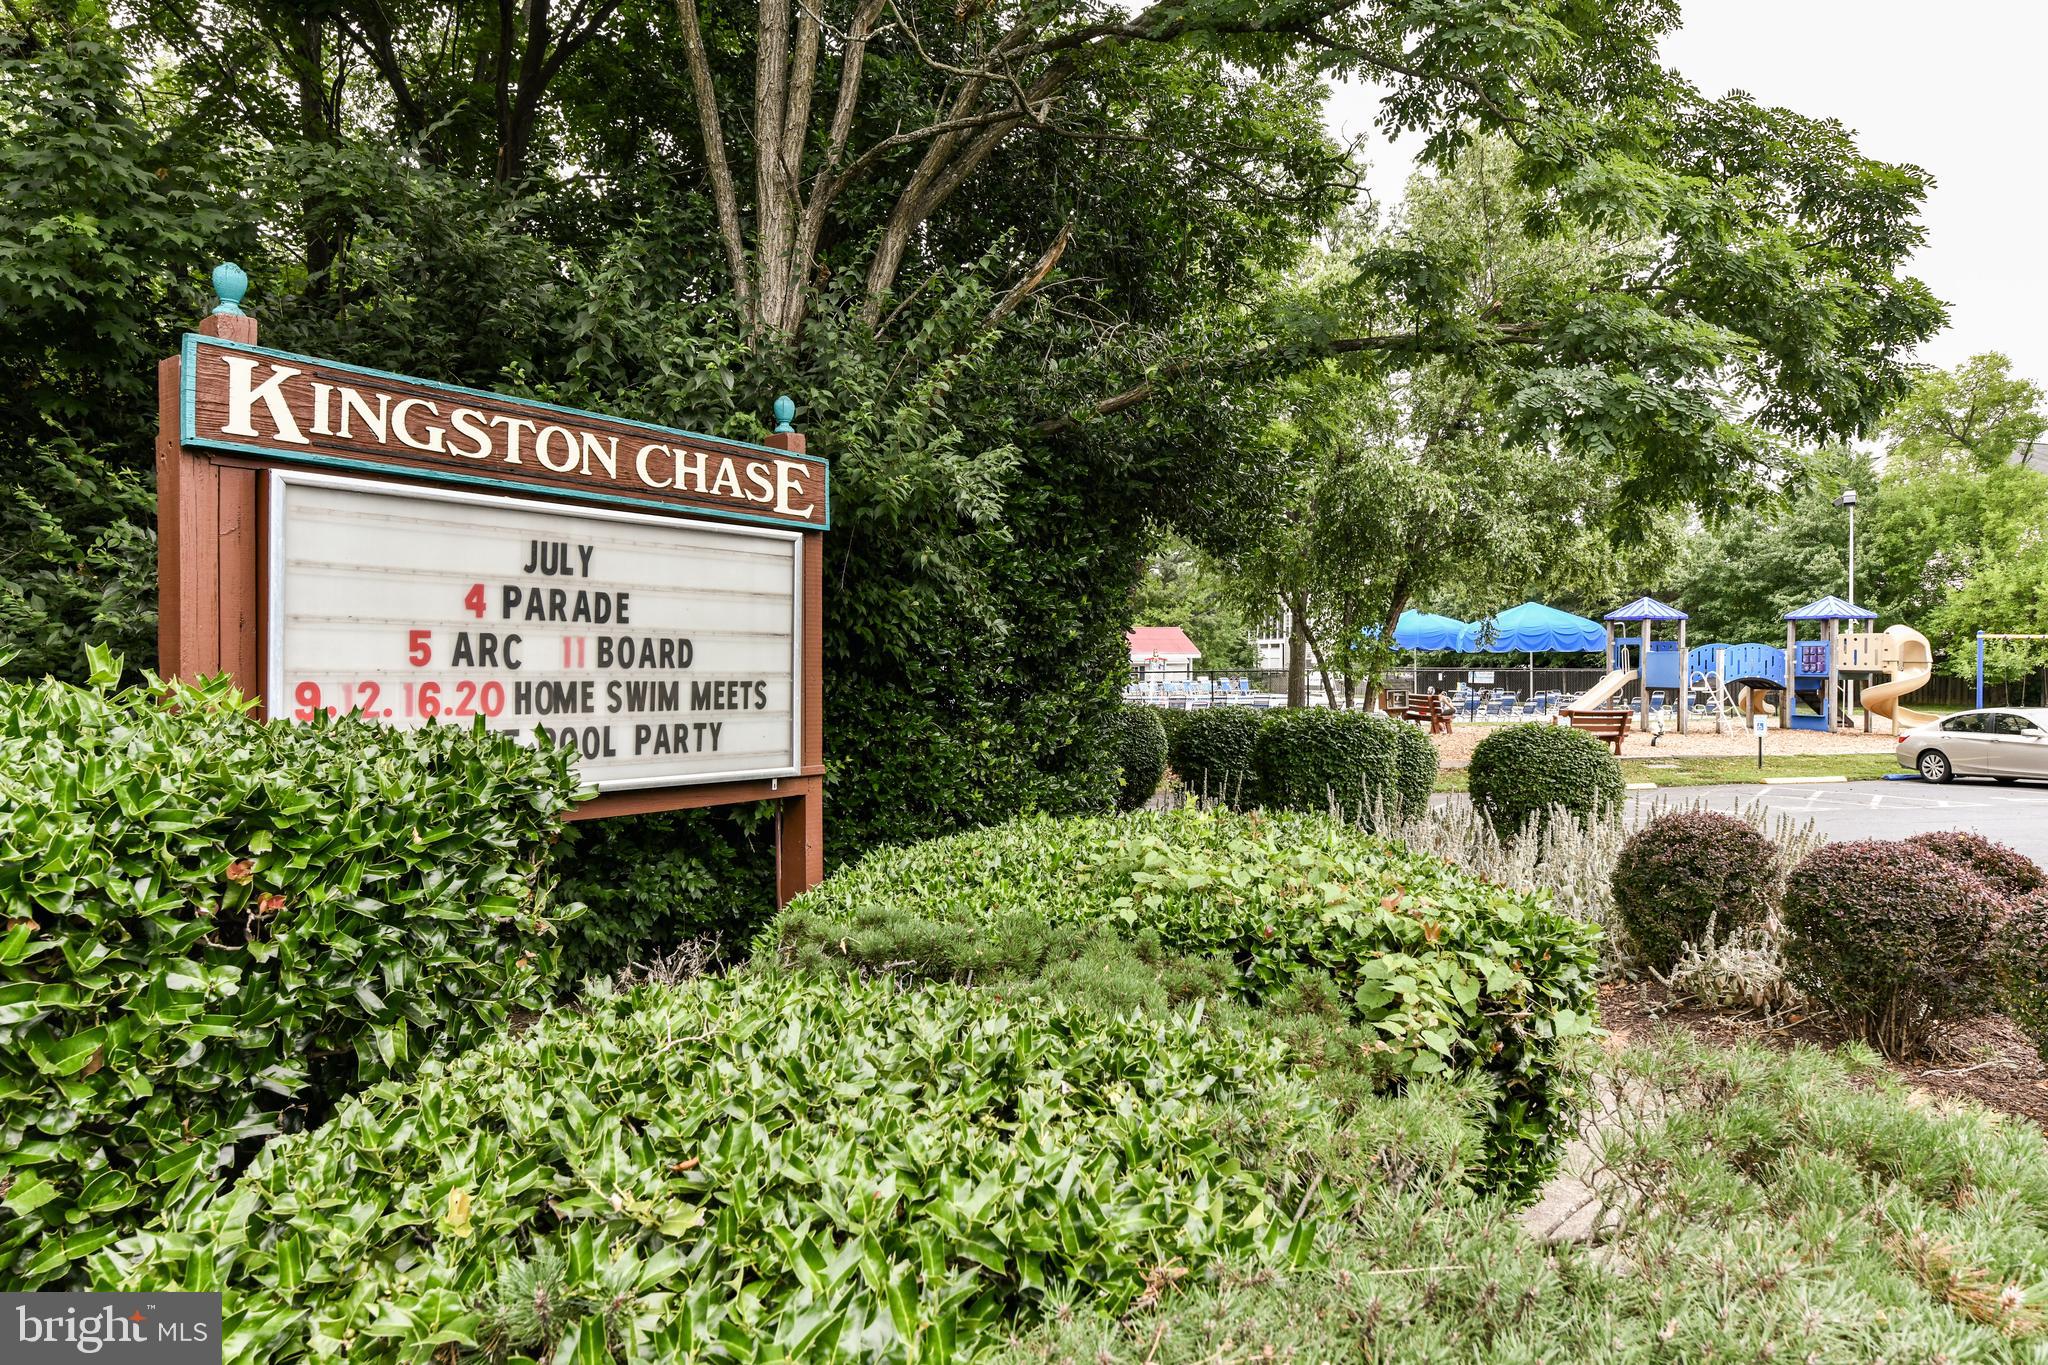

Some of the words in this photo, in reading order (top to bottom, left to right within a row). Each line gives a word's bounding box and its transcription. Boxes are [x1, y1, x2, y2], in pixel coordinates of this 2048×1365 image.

[221, 355, 619, 480] KINGSTON
[635, 444, 815, 519] CHASE
[524, 540, 594, 577] JULY
[464, 583, 487, 619] 4
[502, 585, 630, 624] PARADE
[409, 630, 432, 667] 5
[451, 632, 522, 669] ARC
[563, 636, 585, 668] 11
[597, 636, 694, 669] BOARD
[514, 681, 595, 715] HOME
[606, 680, 680, 713] SWIM
[690, 680, 768, 711] MEETS
[634, 722, 723, 756] PARTY
